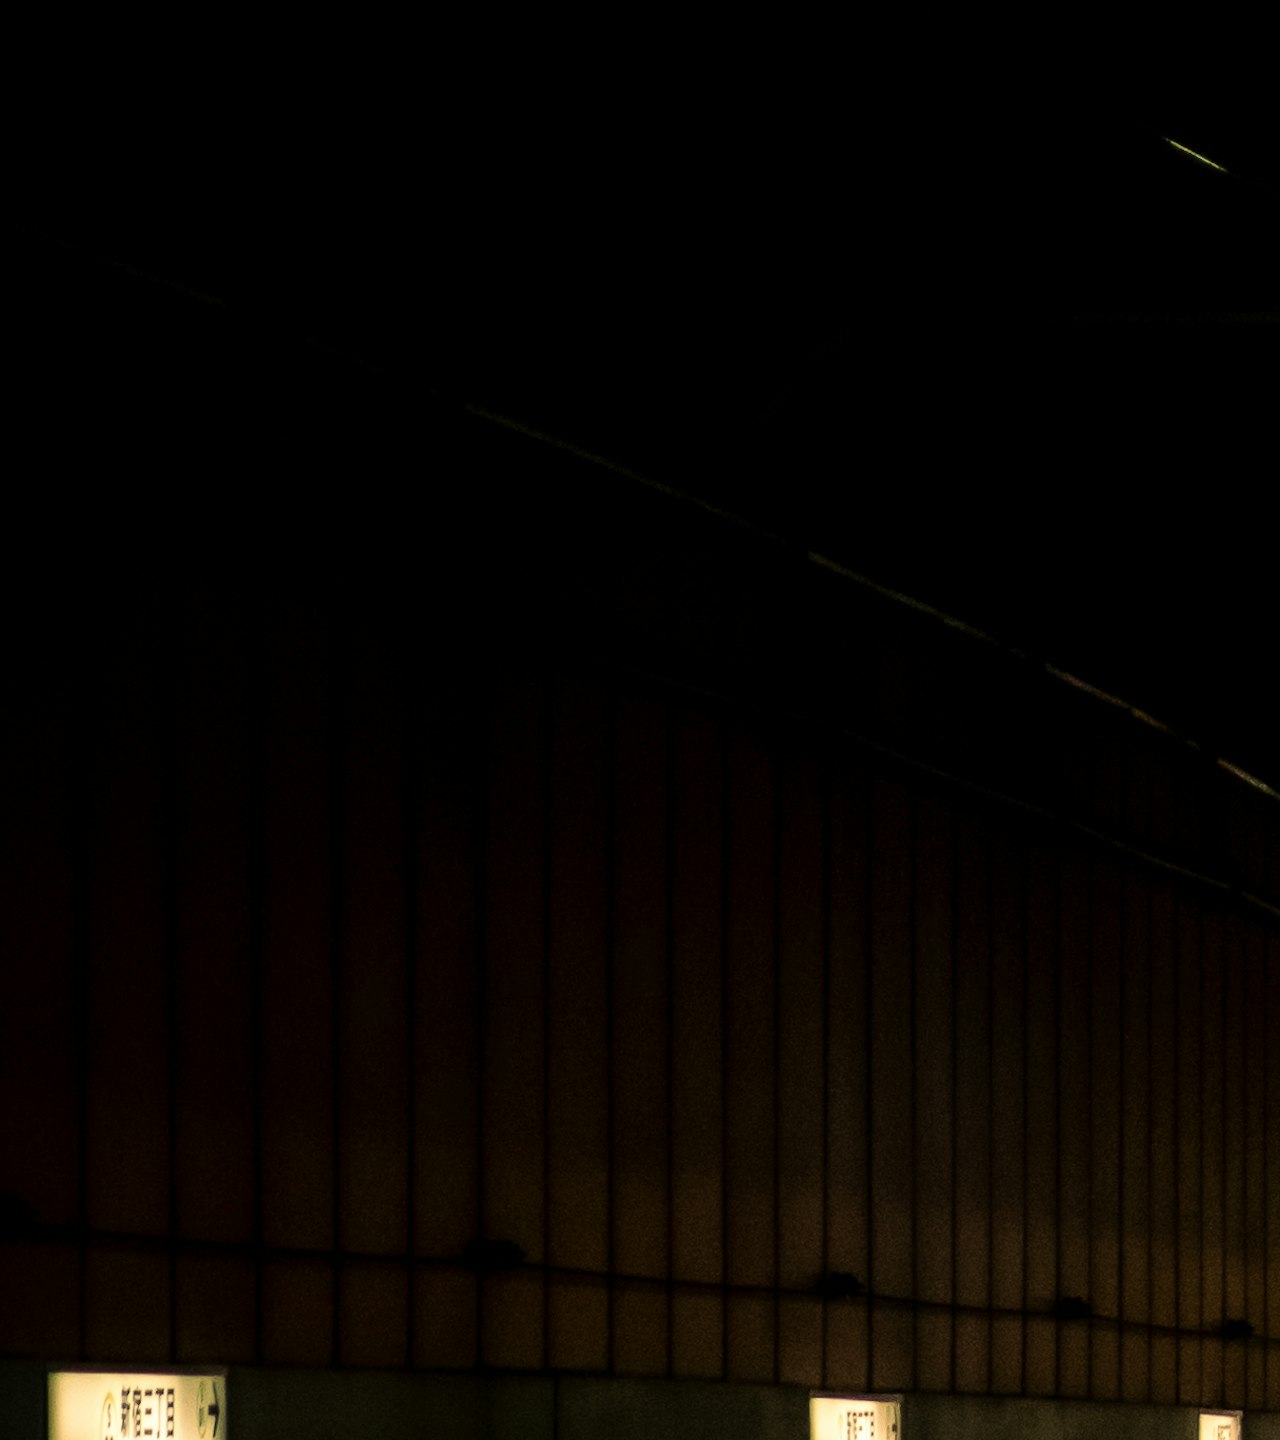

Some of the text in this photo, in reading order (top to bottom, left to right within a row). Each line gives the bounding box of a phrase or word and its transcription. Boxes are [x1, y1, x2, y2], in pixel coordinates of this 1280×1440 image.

[121, 1387, 174, 1438] 新宿三丁目
